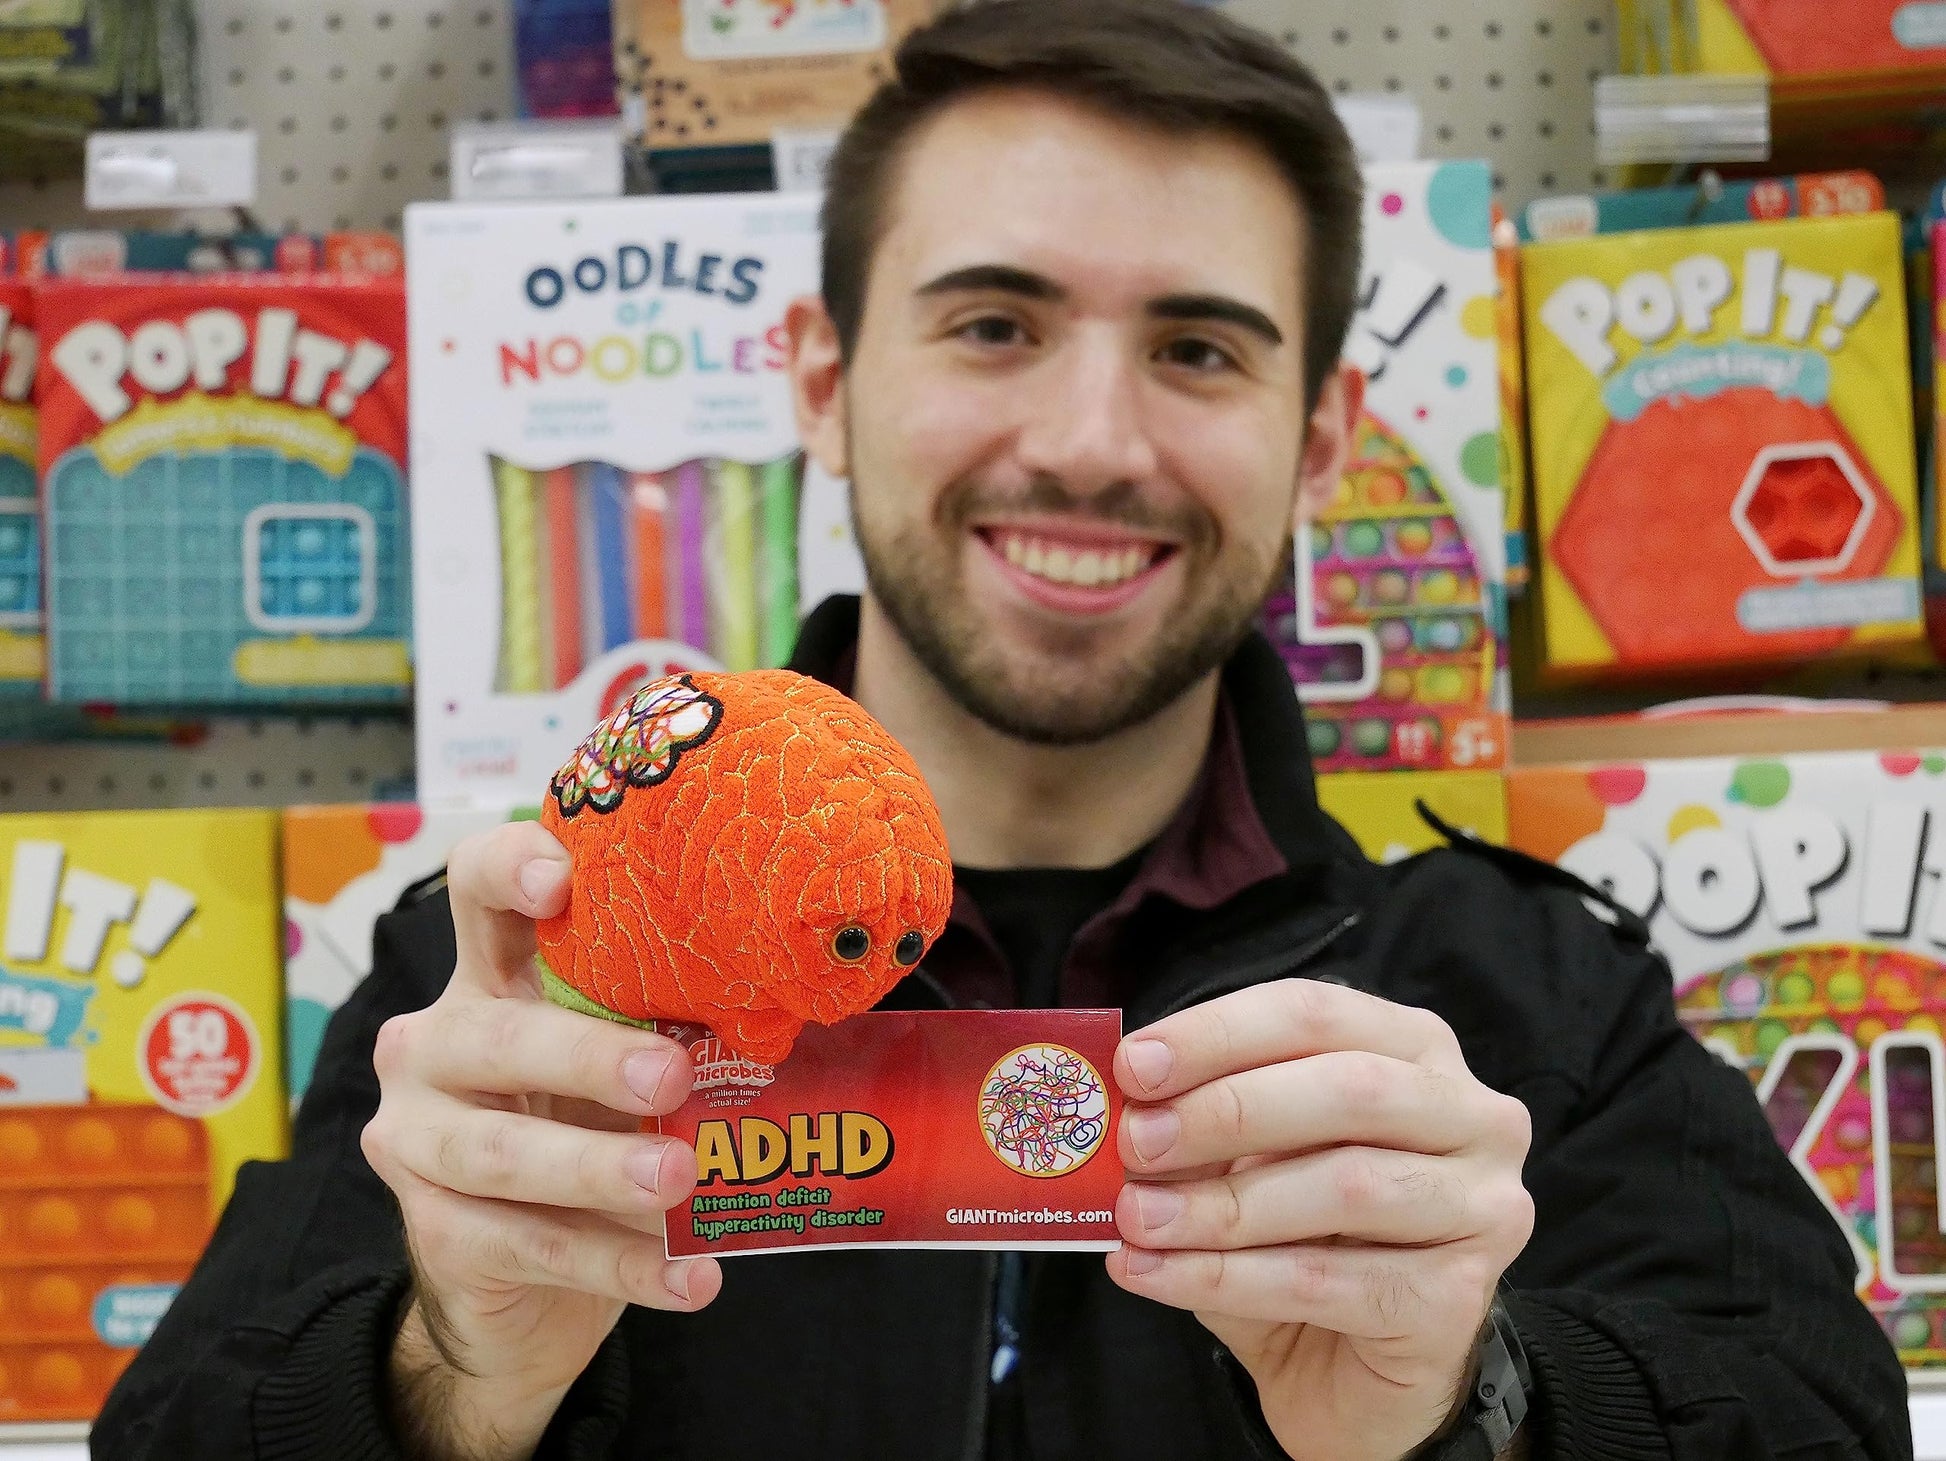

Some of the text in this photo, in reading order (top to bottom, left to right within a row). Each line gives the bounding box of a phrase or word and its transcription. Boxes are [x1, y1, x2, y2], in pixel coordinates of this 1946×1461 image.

[525, 240, 764, 309] OODLES
[615, 300, 664, 326] OF
[1540, 254, 1733, 377] POP
[1741, 248, 1880, 352] IT!
[54, 309, 247, 421] POP
[254, 307, 392, 418] IT!
[498, 324, 790, 389] NOODLES
[3, 838, 198, 990] IT!
[170, 1010, 228, 1060] 50
[708, 1097, 751, 1108] actual size!
[711, 1089, 738, 1098] million
[740, 1088, 761, 1097] times
[695, 1111, 894, 1186] ADHD
[692, 1187, 831, 1212] Attention deficit
[692, 1208, 884, 1240] hyperactivity disorder
[945, 1207, 1113, 1225] GIANTmicrobes.com
